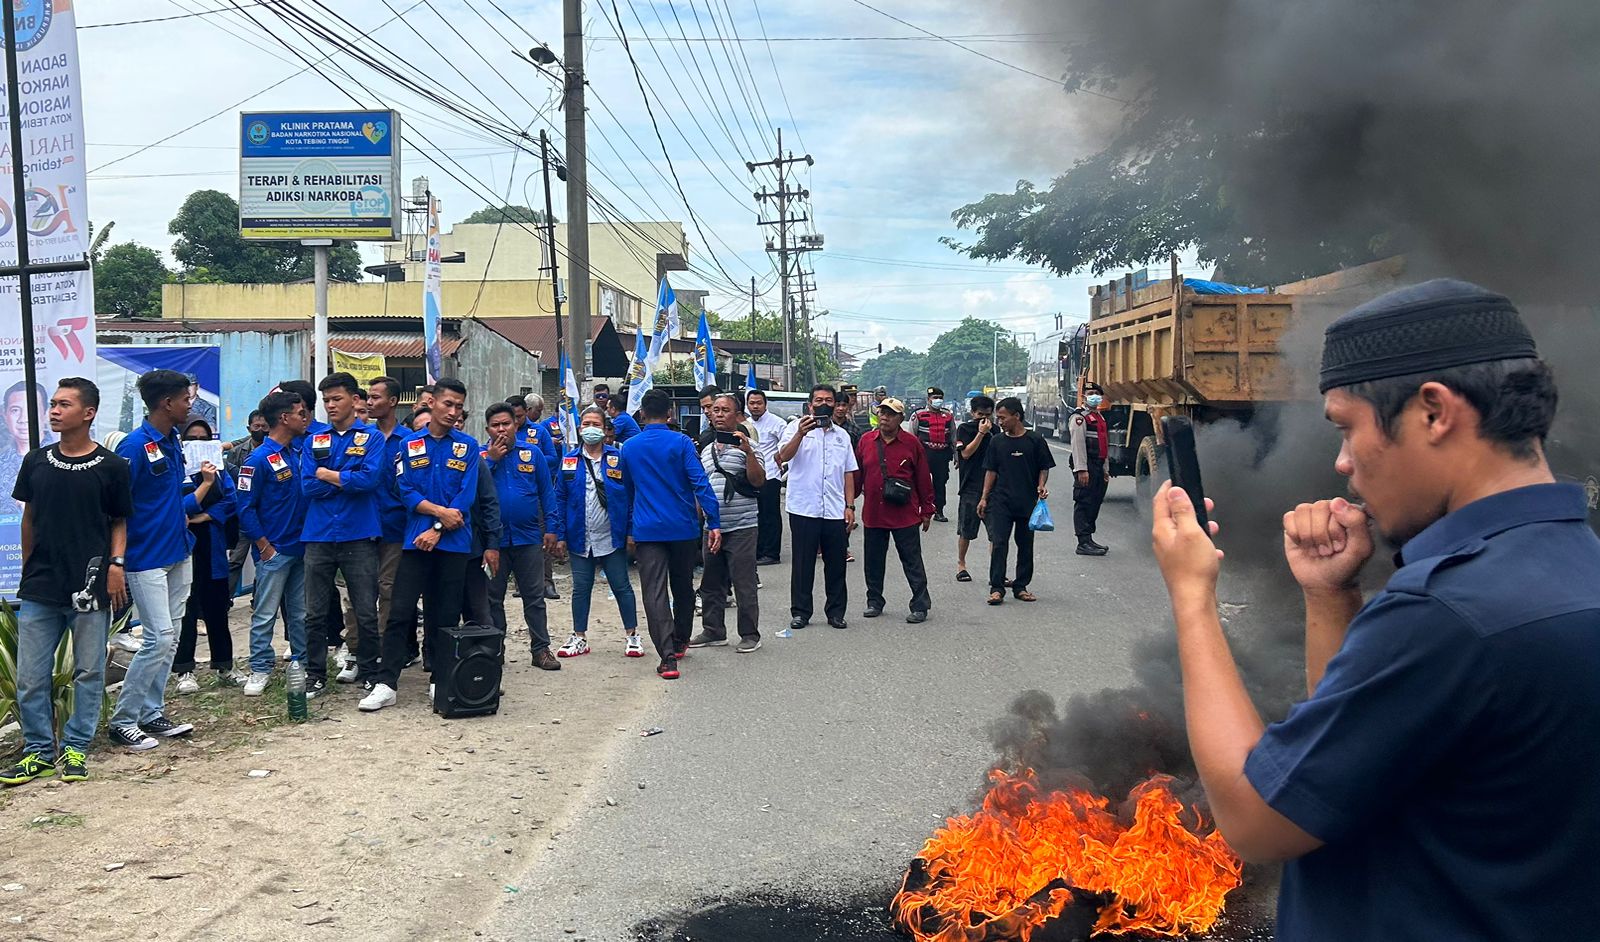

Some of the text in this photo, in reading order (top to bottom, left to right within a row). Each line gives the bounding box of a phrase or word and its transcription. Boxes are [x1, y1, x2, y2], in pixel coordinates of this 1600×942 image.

[280, 121, 354, 131] KLINIK PRATAMA
[247, 174, 382, 186] TERAPI & REHABILITASI
[266, 190, 364, 202] ADIKSI NARKOBA
[356, 198, 384, 208] STOP
